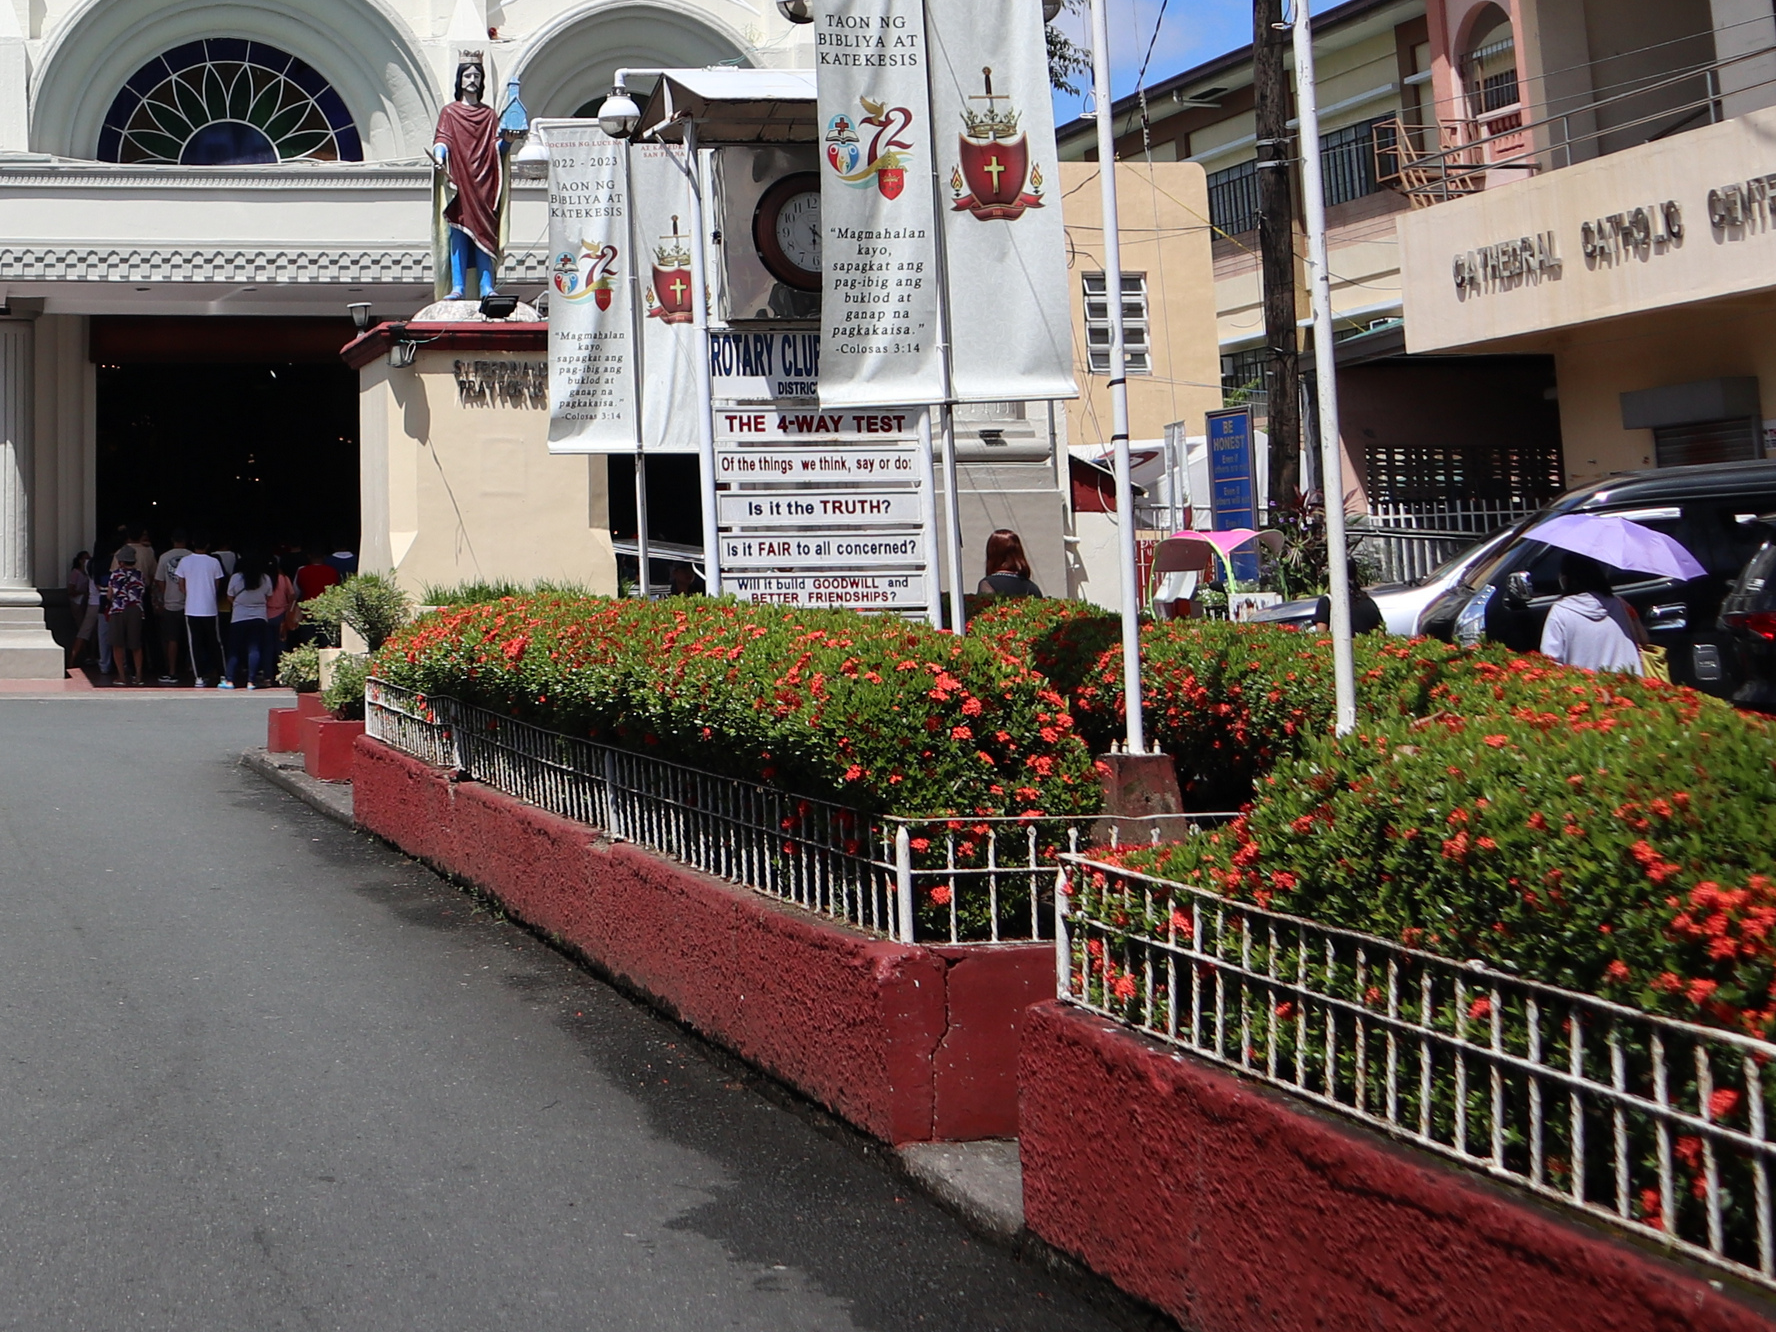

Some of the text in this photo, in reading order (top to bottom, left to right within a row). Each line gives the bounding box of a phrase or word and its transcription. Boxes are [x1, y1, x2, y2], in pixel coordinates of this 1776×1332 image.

[825, 14, 906, 29] TAON NG
[818, 33, 918, 48] BIBLIYA AT
[819, 52, 918, 67] KATEKESIS
[552, 157, 575, 168] 022
[590, 156, 618, 167] 2023
[596, 180, 615, 190] NG
[550, 193, 623, 205] BIBLIYA AT
[806, 198, 817, 209] 12
[550, 207, 623, 219] KATEKESIS
[794, 202, 802, 214] 11
[784, 213, 796, 224] 10
[782, 228, 790, 238] 9
[787, 241, 795, 251] 8
[1452, 229, 1562, 288] CATHEDRAL
[1580, 199, 1685, 258] CATHOLIC
[857, 244, 892, 257] kayo,
[799, 252, 805, 263] 7
[812, 256, 820, 267] 6
[832, 260, 924, 274] sapagkat ang
[834, 275, 922, 290] pag-ibig ang
[844, 292, 912, 304] buklod at
[845, 310, 910, 322] ganap na
[577, 343, 603, 352] kayo,
[835, 343, 920, 354] -Colosas 3:14
[557, 353, 623, 364] sapagkat ang
[711, 334, 775, 377] ROTARY
[559, 365, 622, 375] pag-ibig ang
[567, 376, 601, 385] buklod
[569, 389, 597, 398] ganap
[777, 381, 818, 395] DISTRIC
[561, 412, 621, 420] -Colosas 3:14
[724, 415, 906, 433] THE 4-WAY TEST
[1222, 420, 1234, 434] BE
[1213, 434, 1245, 451] HONEST
[721, 456, 912, 474] Of the things we think, say or do:
[748, 499, 891, 516] Is it the TRUTH?
[727, 539, 917, 557] Is it FAIR to all concerned?
[737, 577, 909, 590] Will it build GOODWILL and
[751, 591, 897, 603] BETTER FRIENDSHIPS?
